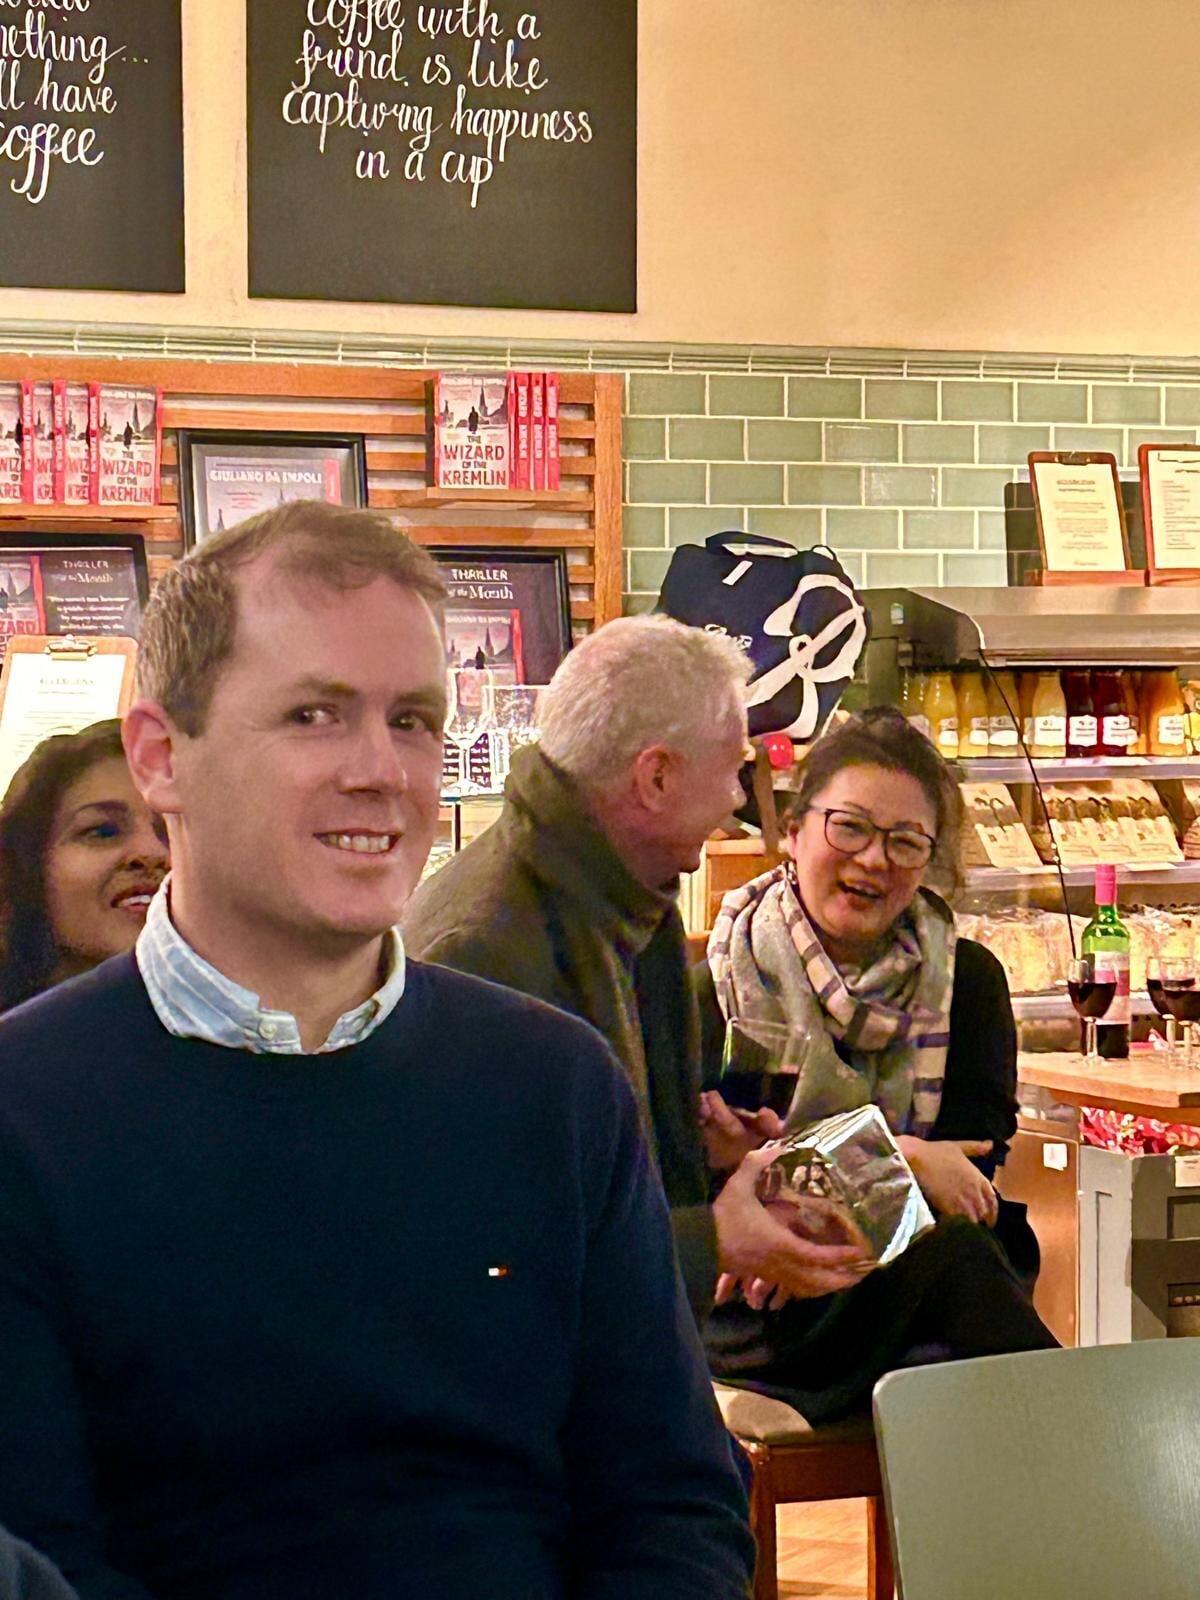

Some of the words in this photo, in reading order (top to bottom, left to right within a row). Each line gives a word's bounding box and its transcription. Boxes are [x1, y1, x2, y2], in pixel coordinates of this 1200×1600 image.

[417, 0, 504, 39] with
[517, 14, 542, 40] a
[296, 29, 407, 90] friend
[422, 35, 451, 86] is
[468, 39, 549, 90] like
[34, 58, 118, 114] have
[282, 78, 443, 154] capturing
[450, 84, 593, 162] happiness
[0, 122, 105, 204] offee
[355, 131, 390, 179] in
[404, 150, 426, 182] a
[440, 151, 494, 208] cup
[443, 444, 505, 460] WIZARD
[102, 459, 152, 477] WIZARD
[442, 470, 506, 485] KREMLIN
[102, 485, 152, 502] KREMLIN
[451, 568, 508, 581] THRILLER
[468, 585, 514, 600] Month
